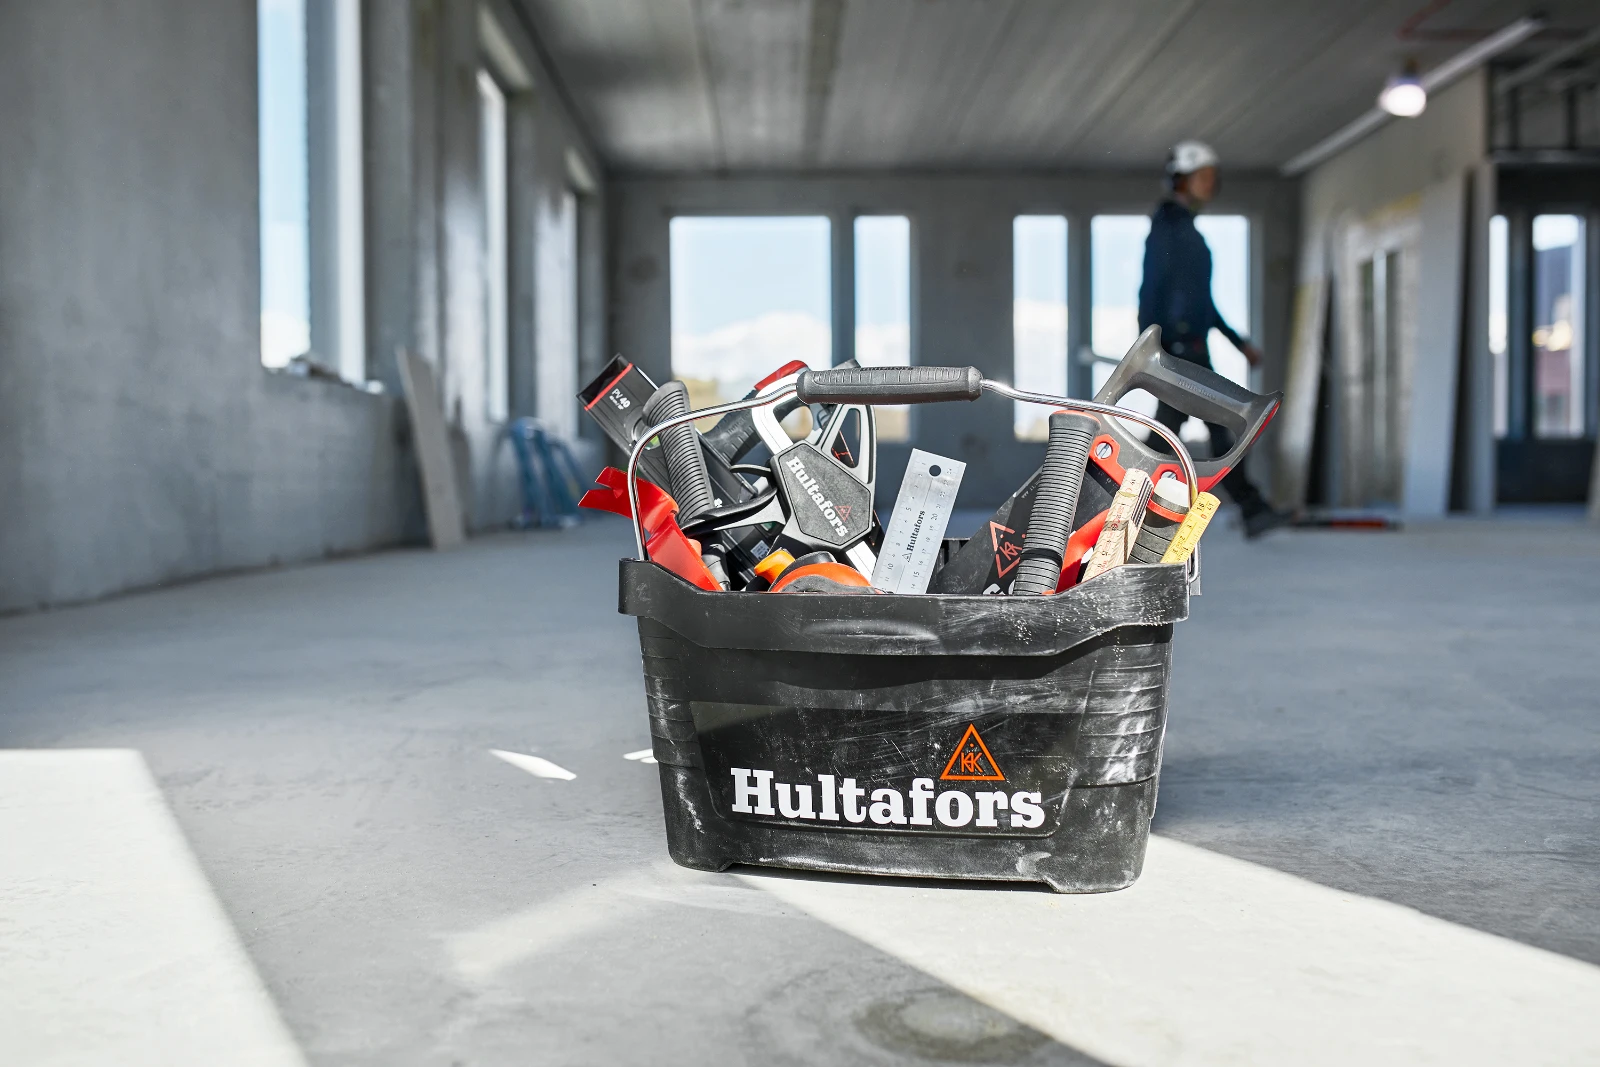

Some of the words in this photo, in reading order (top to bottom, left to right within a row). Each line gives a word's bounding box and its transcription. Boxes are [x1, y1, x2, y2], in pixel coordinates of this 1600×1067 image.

[611, 388, 623, 399] PV
[619, 397, 631, 408] 40
[785, 455, 849, 537] Hultafors
[906, 510, 926, 552] Hultafors
[930, 513, 939, 521] 20
[887, 563, 894, 571] 10
[730, 767, 1046, 828] Hultafors
